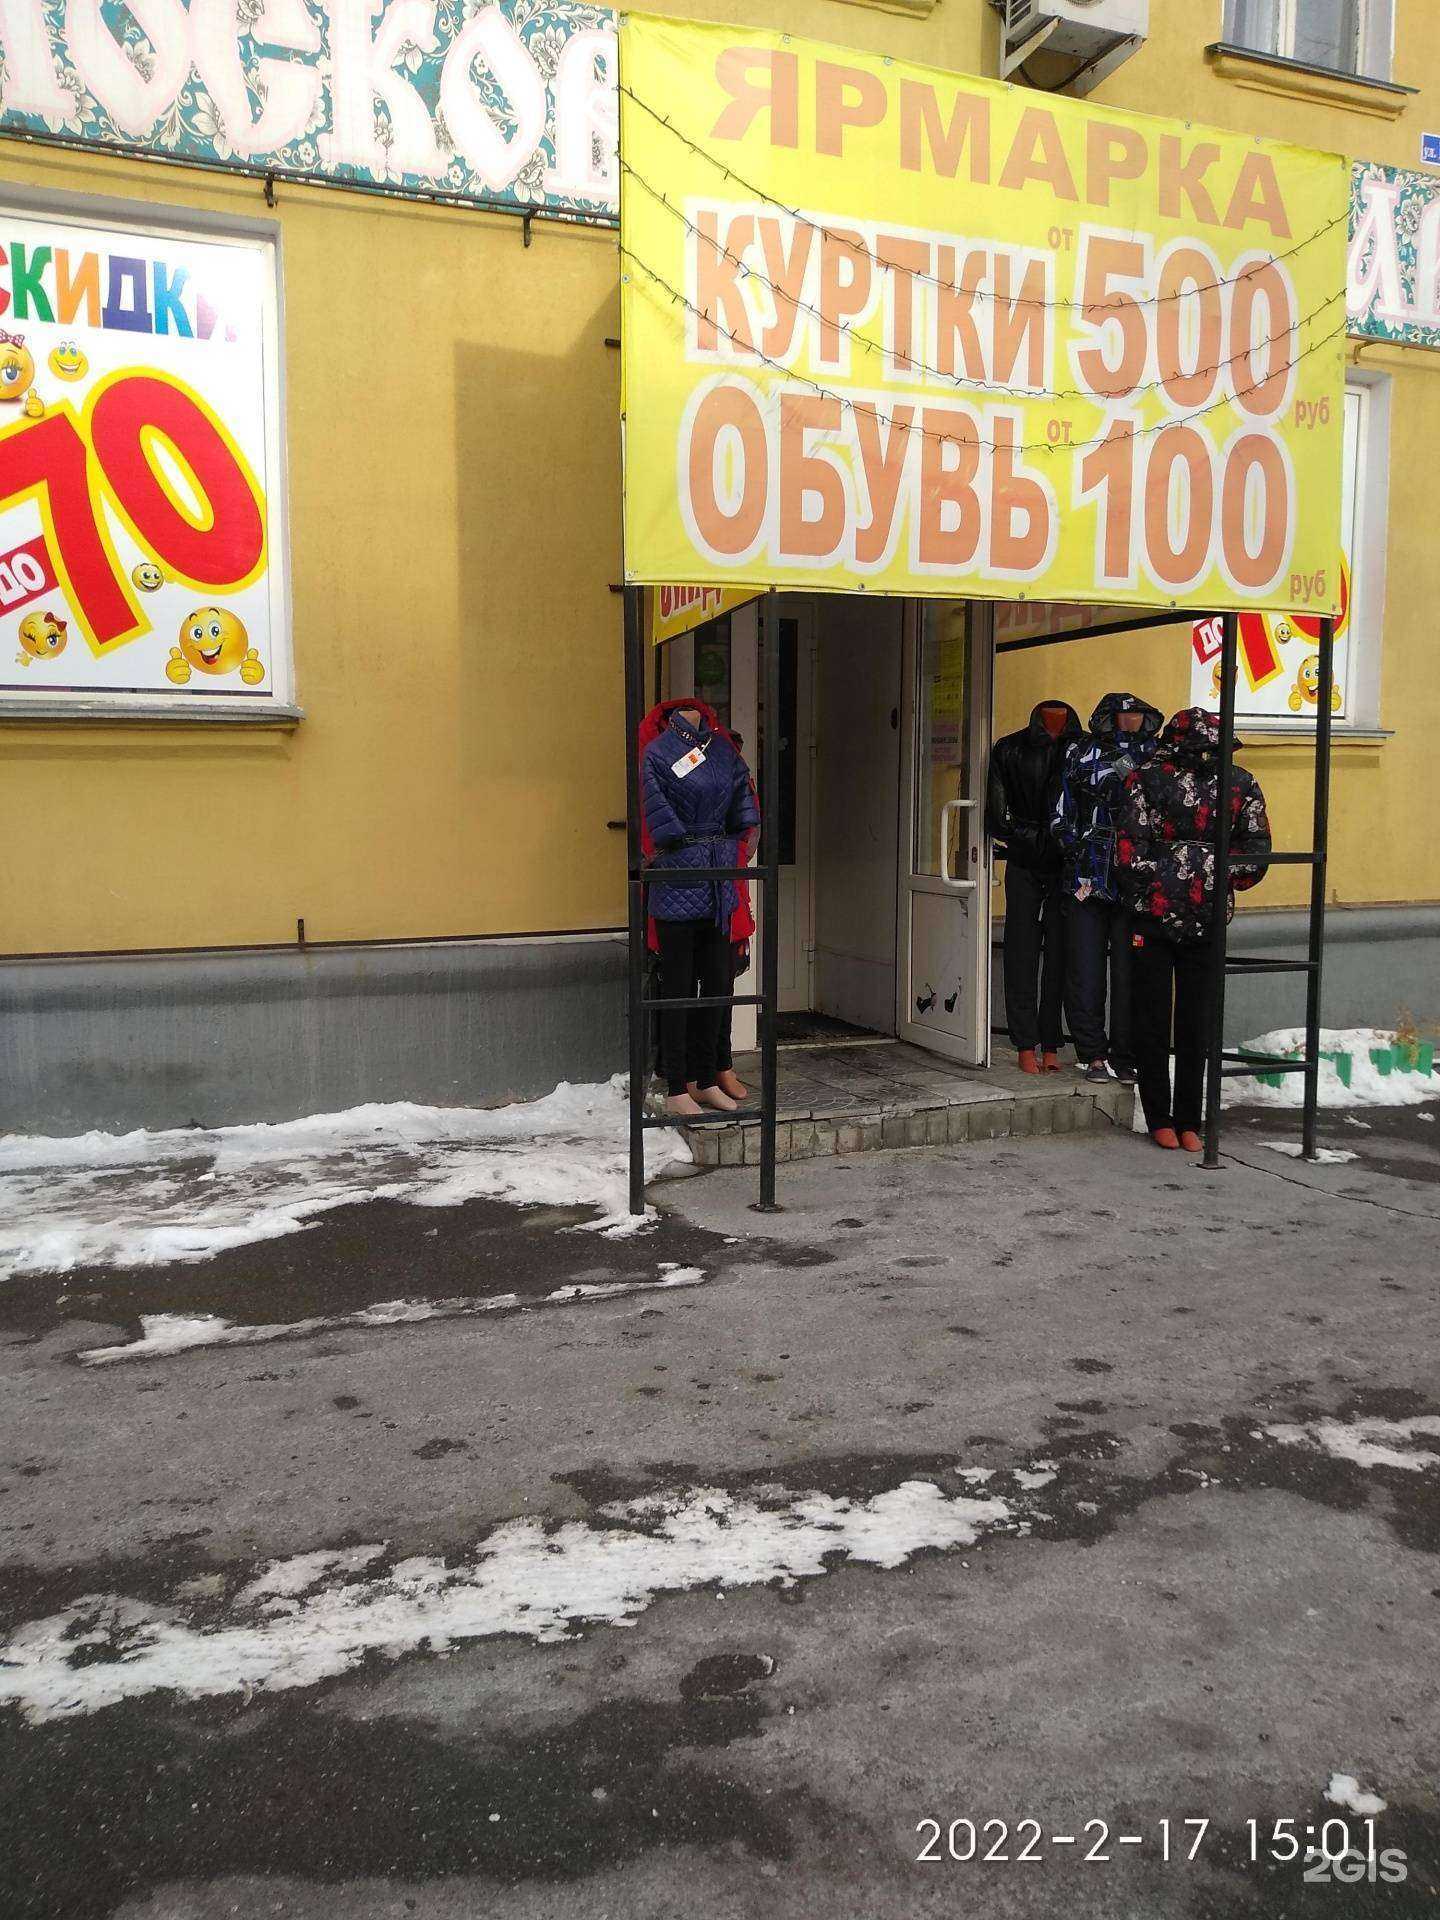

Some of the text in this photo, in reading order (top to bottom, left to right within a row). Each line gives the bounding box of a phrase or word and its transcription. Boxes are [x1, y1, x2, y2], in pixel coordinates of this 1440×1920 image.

[710, 47, 1292, 239] ЯРМАРКА
[693, 207, 1331, 430] КУРТКИ от 500 руб
[688, 384, 1327, 603] ОБУВЬ от 100 руб
